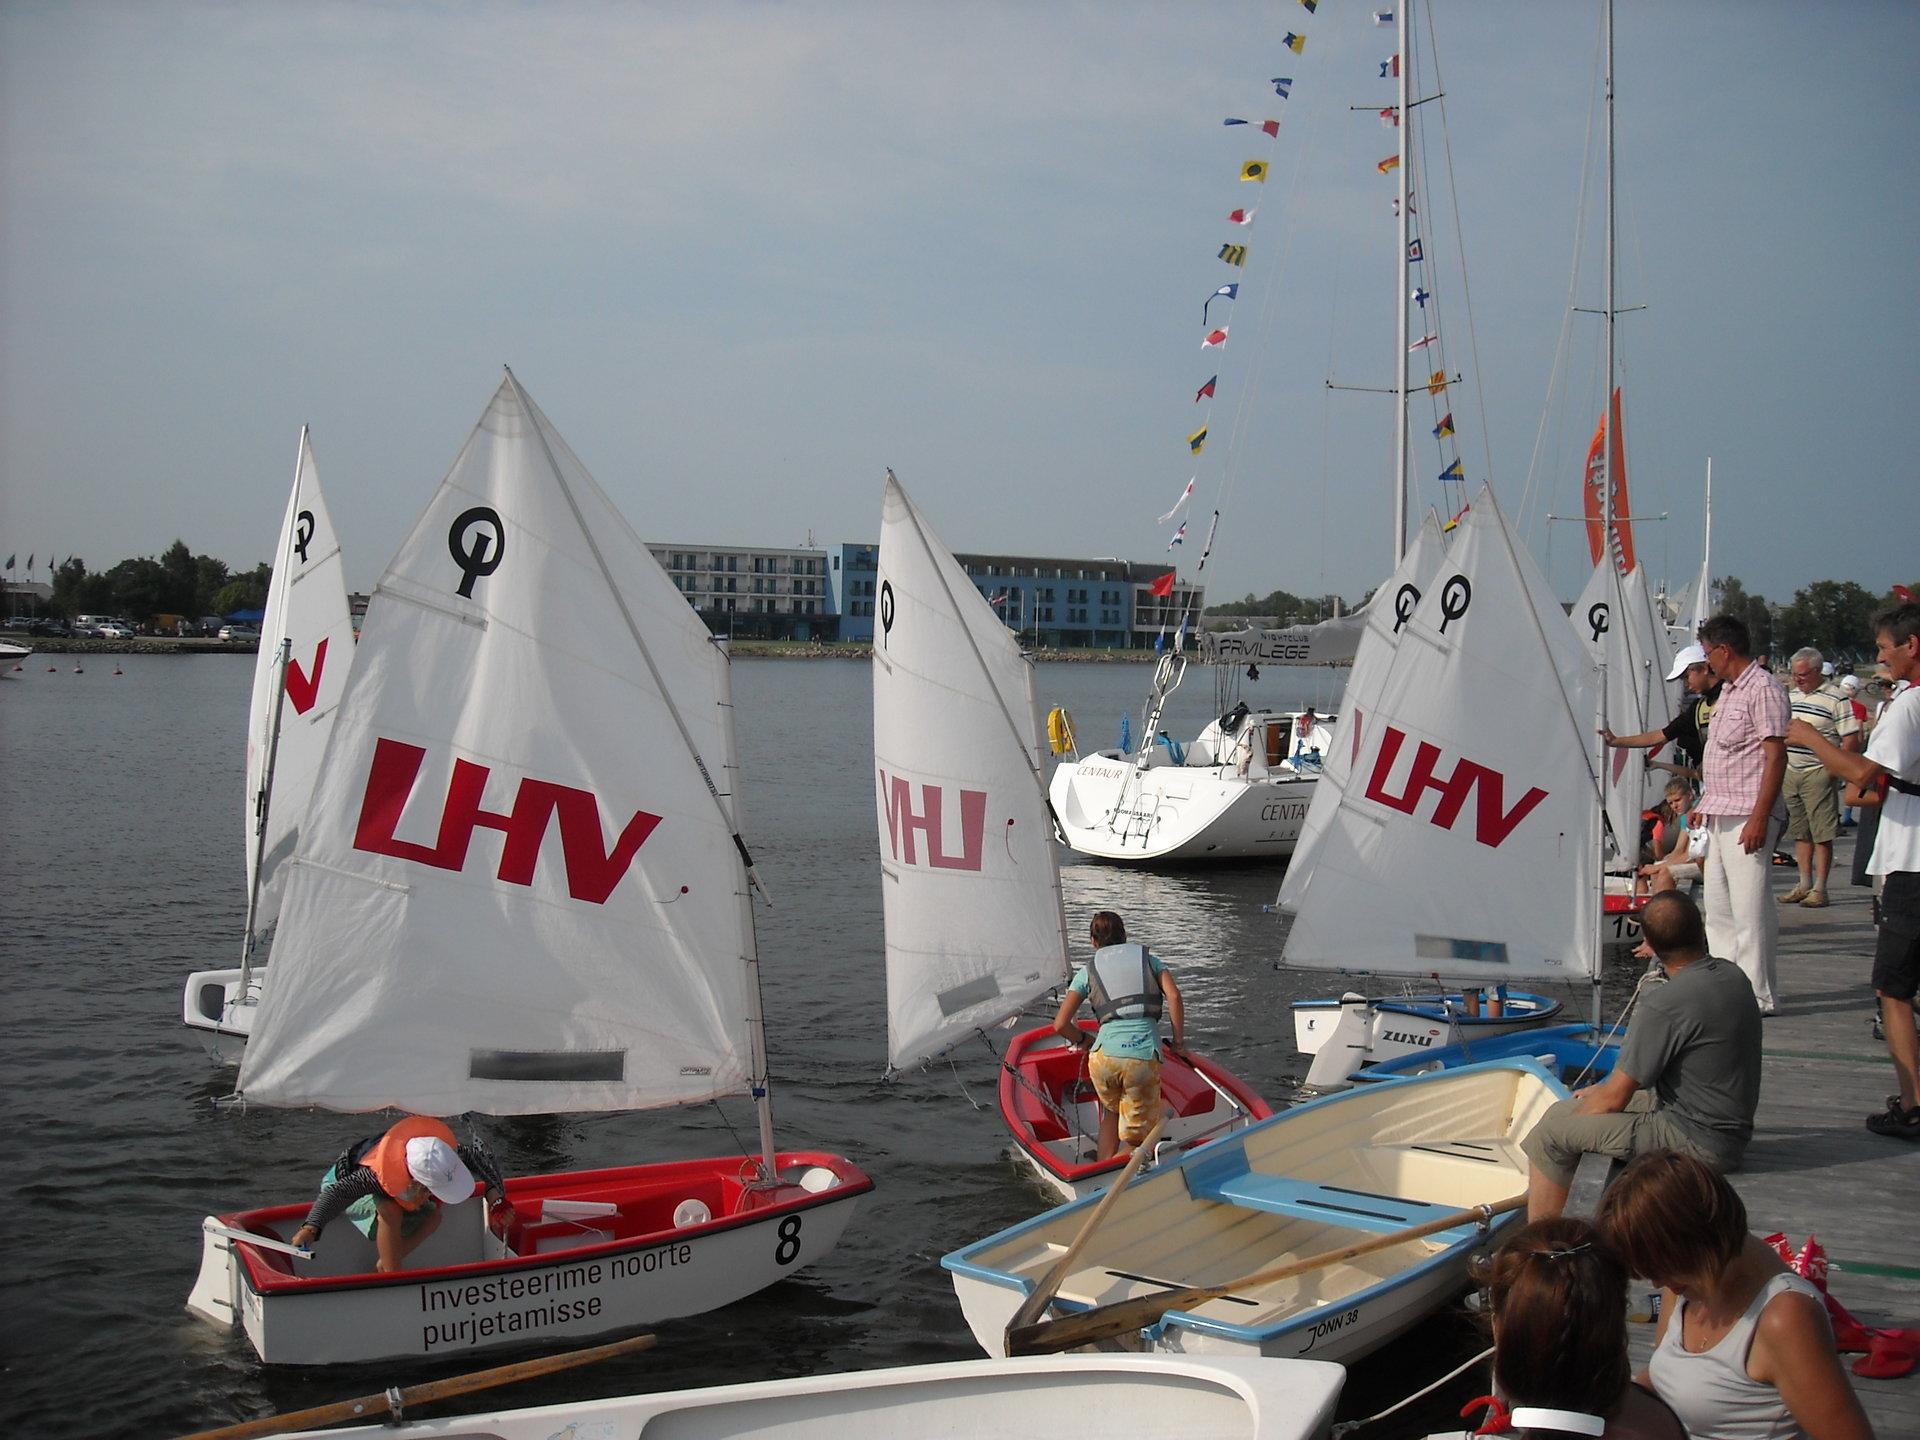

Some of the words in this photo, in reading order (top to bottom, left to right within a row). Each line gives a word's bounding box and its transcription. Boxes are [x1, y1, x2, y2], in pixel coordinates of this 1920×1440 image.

[1219, 638, 1311, 660] PRIVILEGE
[1260, 632, 1309, 643] NIGHTCLUB
[1077, 765, 1123, 780] CENTAUR
[1364, 726, 1550, 849] LHV
[352, 737, 664, 905] LHV
[1382, 1030, 1433, 1047] ZUXU
[774, 1214, 802, 1267] 8
[420, 1266, 602, 1312] Investeerime
[610, 1243, 692, 1281] noorte
[423, 1296, 602, 1351] purjetamisse
[1345, 1309, 1359, 1326] 38
